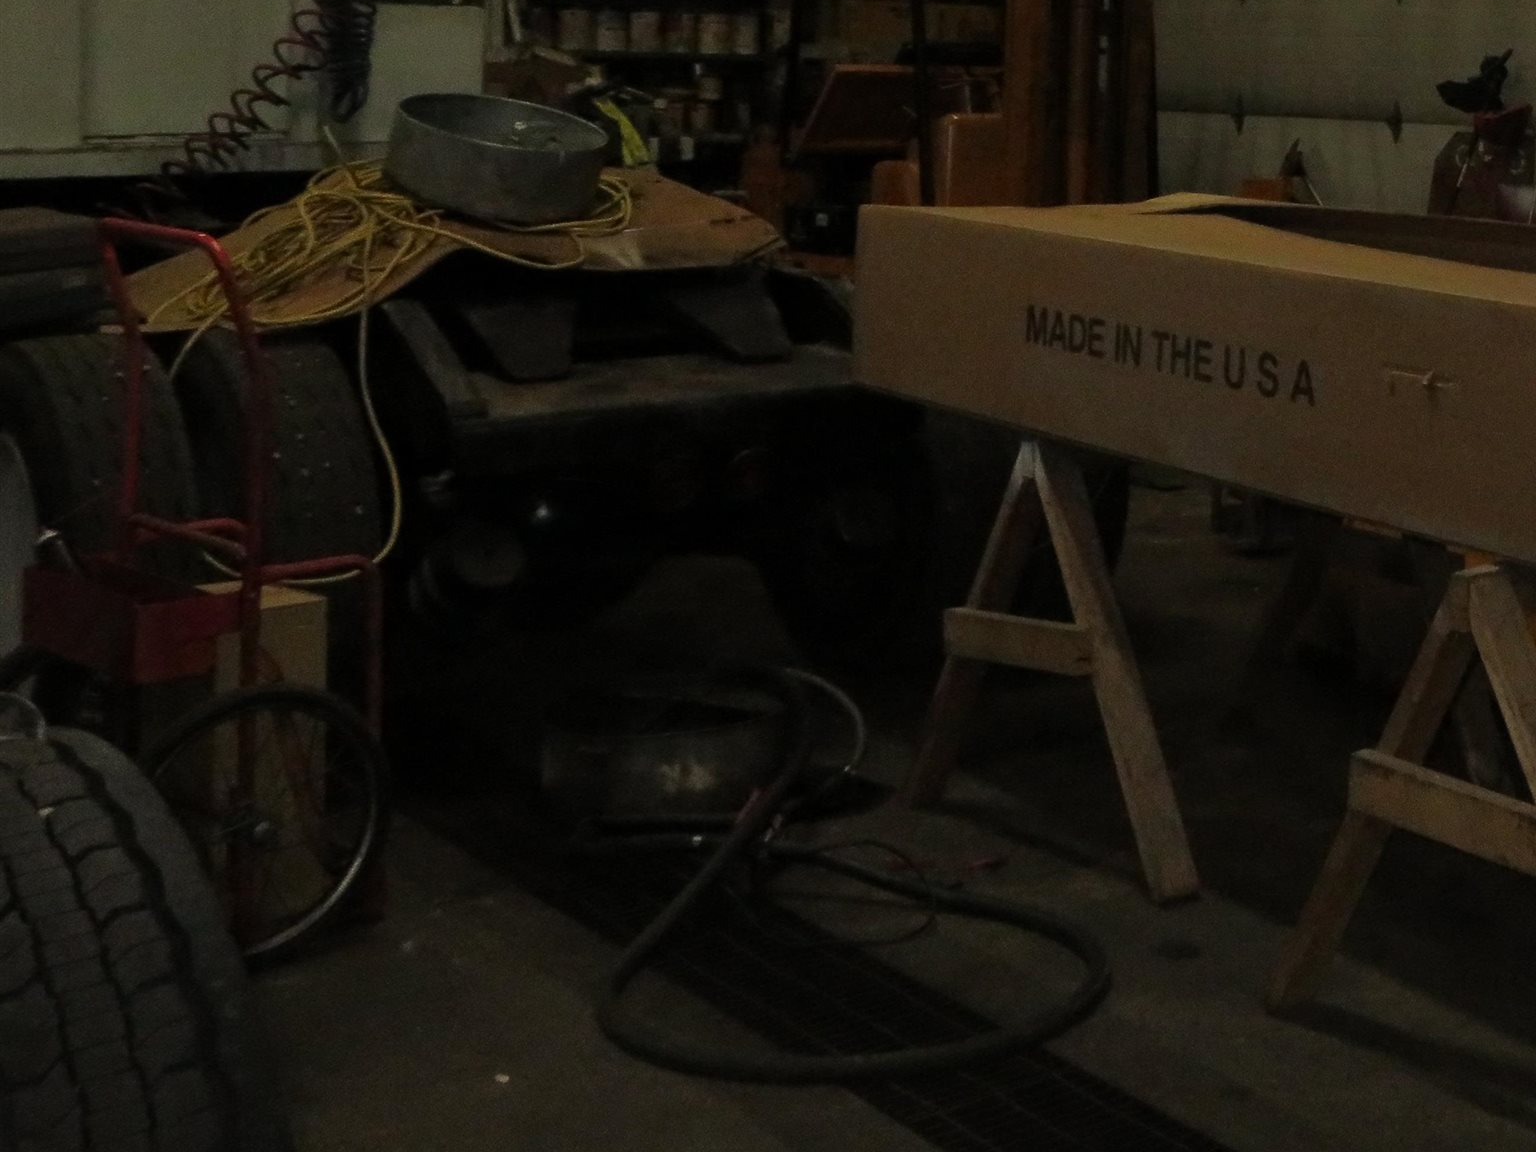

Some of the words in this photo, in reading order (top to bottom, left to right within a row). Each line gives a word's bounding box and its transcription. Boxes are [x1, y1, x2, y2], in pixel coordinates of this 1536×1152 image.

[1025, 304, 1106, 359] MADE
[1114, 322, 1142, 368] IN
[1151, 330, 1213, 383] THE
